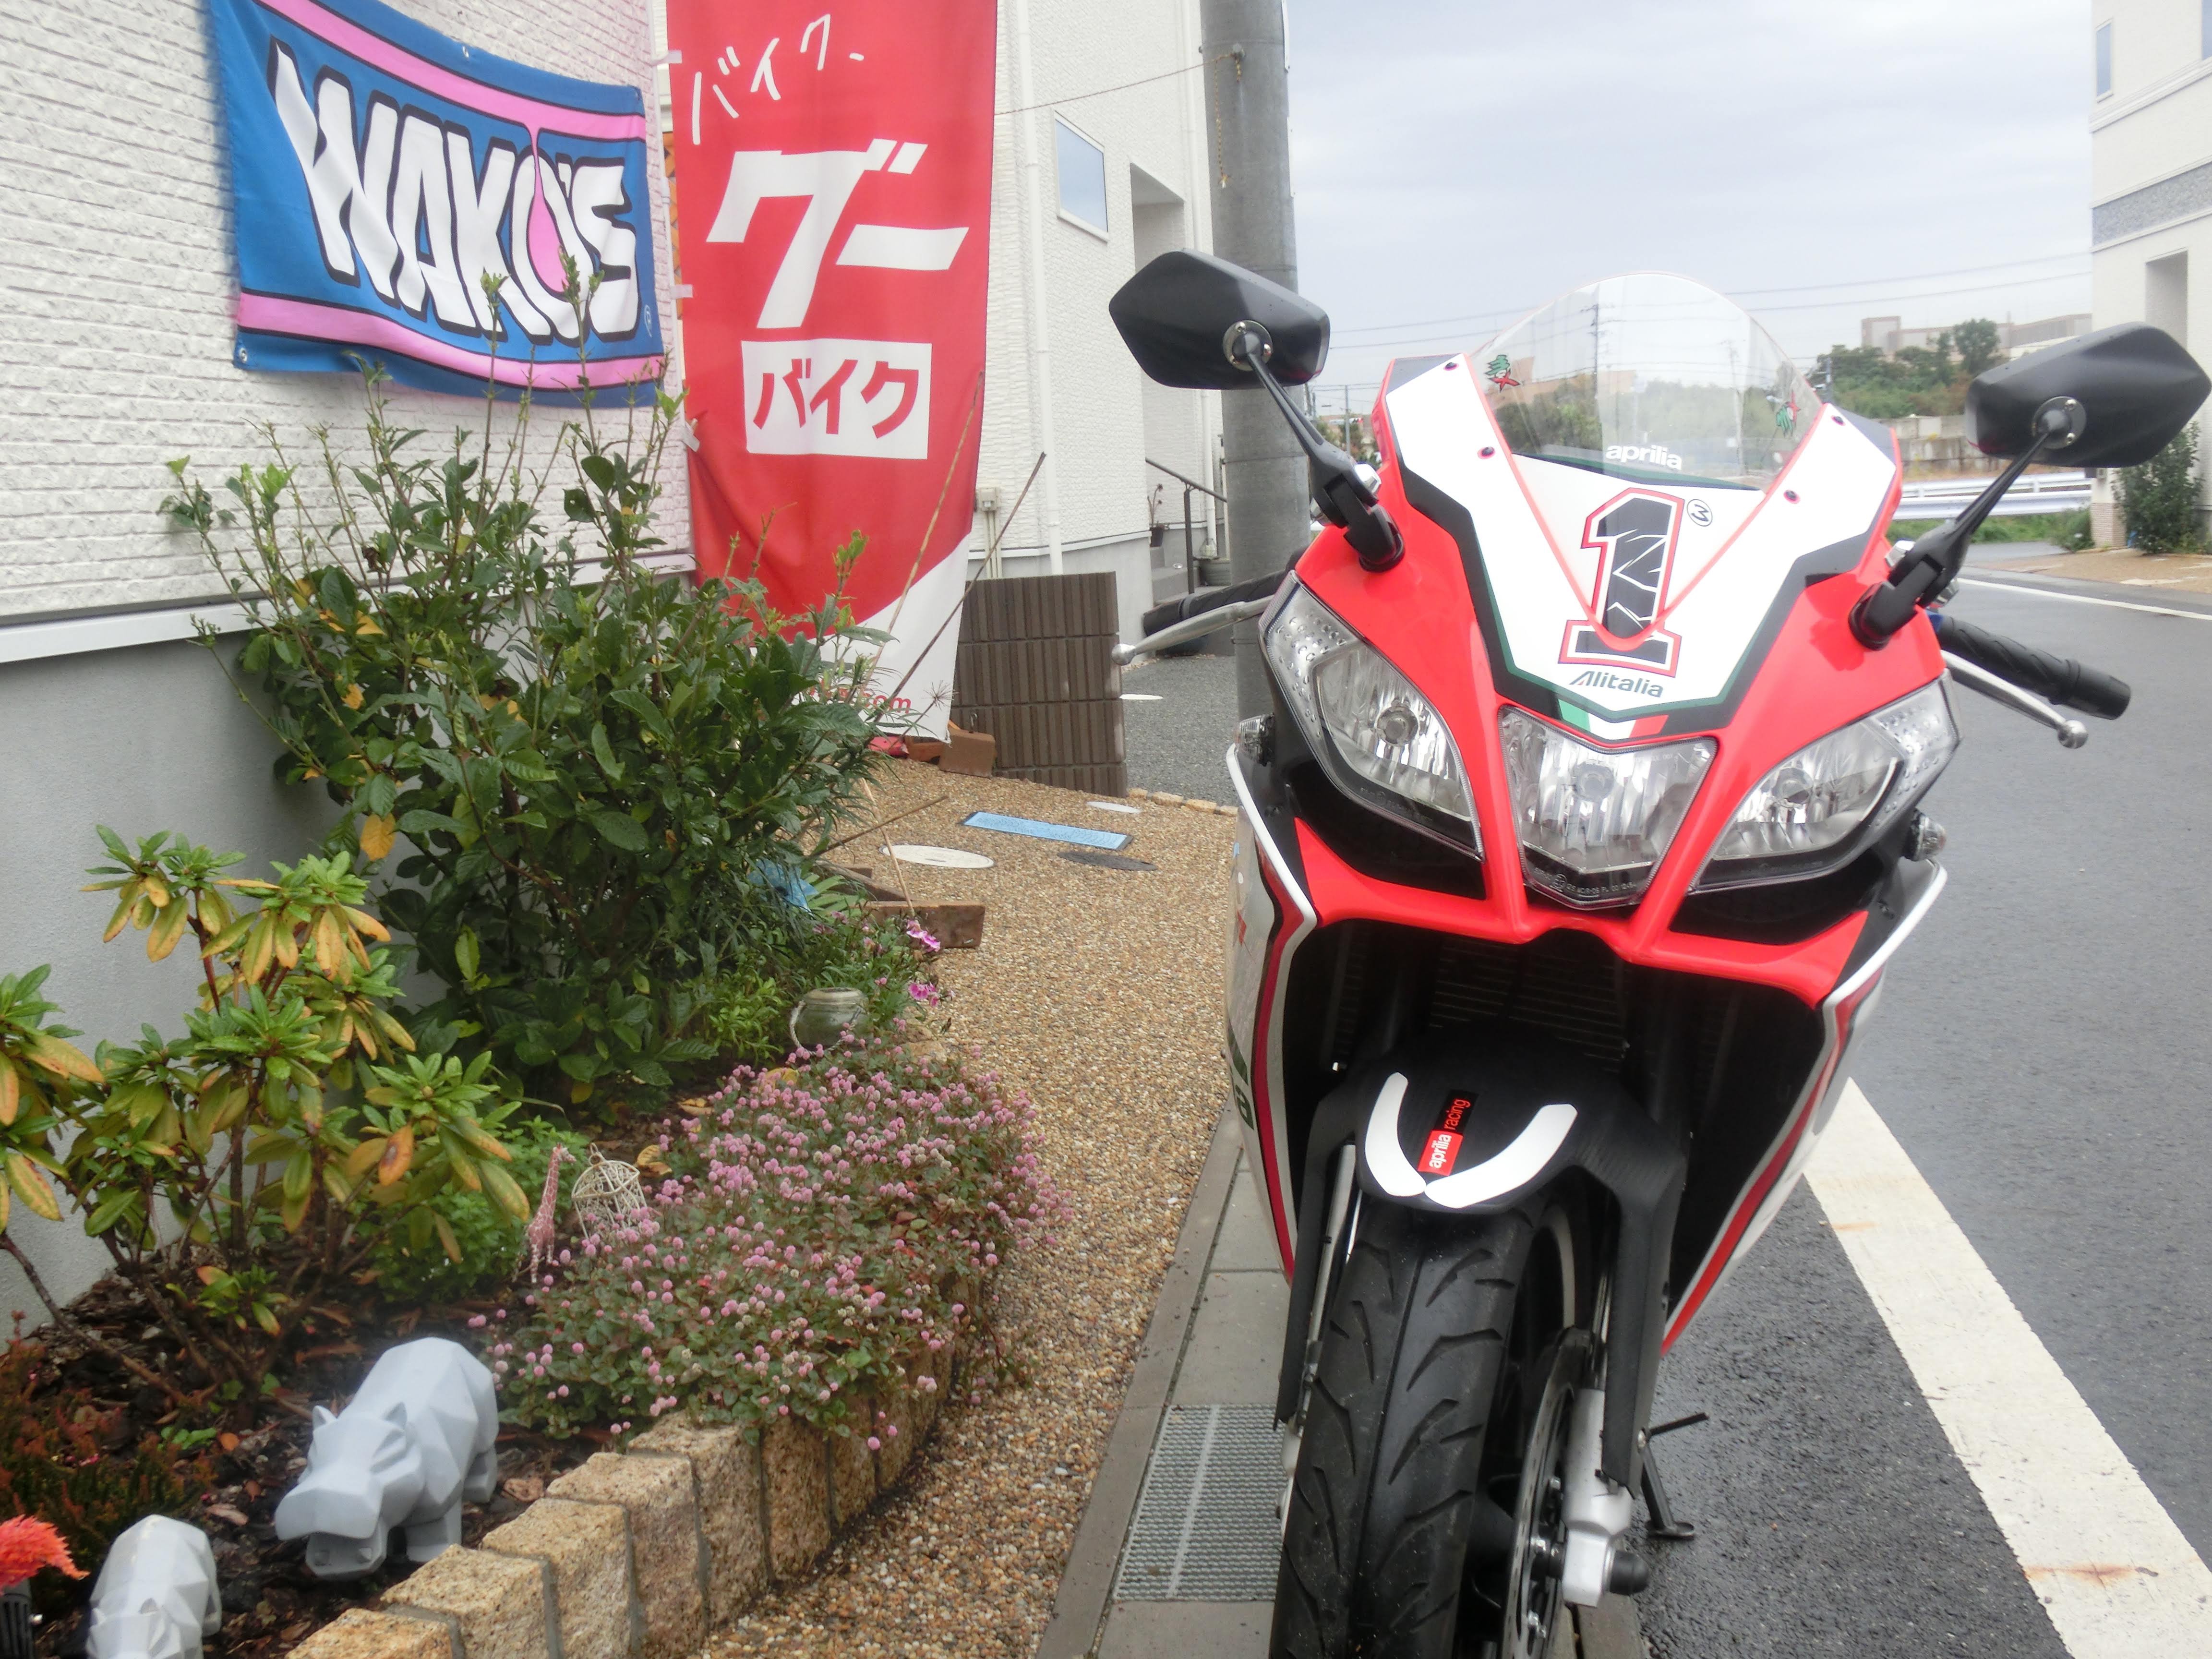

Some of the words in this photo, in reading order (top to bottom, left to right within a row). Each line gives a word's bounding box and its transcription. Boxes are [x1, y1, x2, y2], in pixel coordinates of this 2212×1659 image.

[706, 138, 969, 329] グー
[753, 358, 919, 439] バイク
[1605, 445, 1682, 470] aprilia
[1558, 487, 1685, 678] 1
[1569, 671, 1664, 698] Alitalia
[1429, 1134, 1452, 1169] aprilia
[1443, 1098, 1471, 1130] racing
